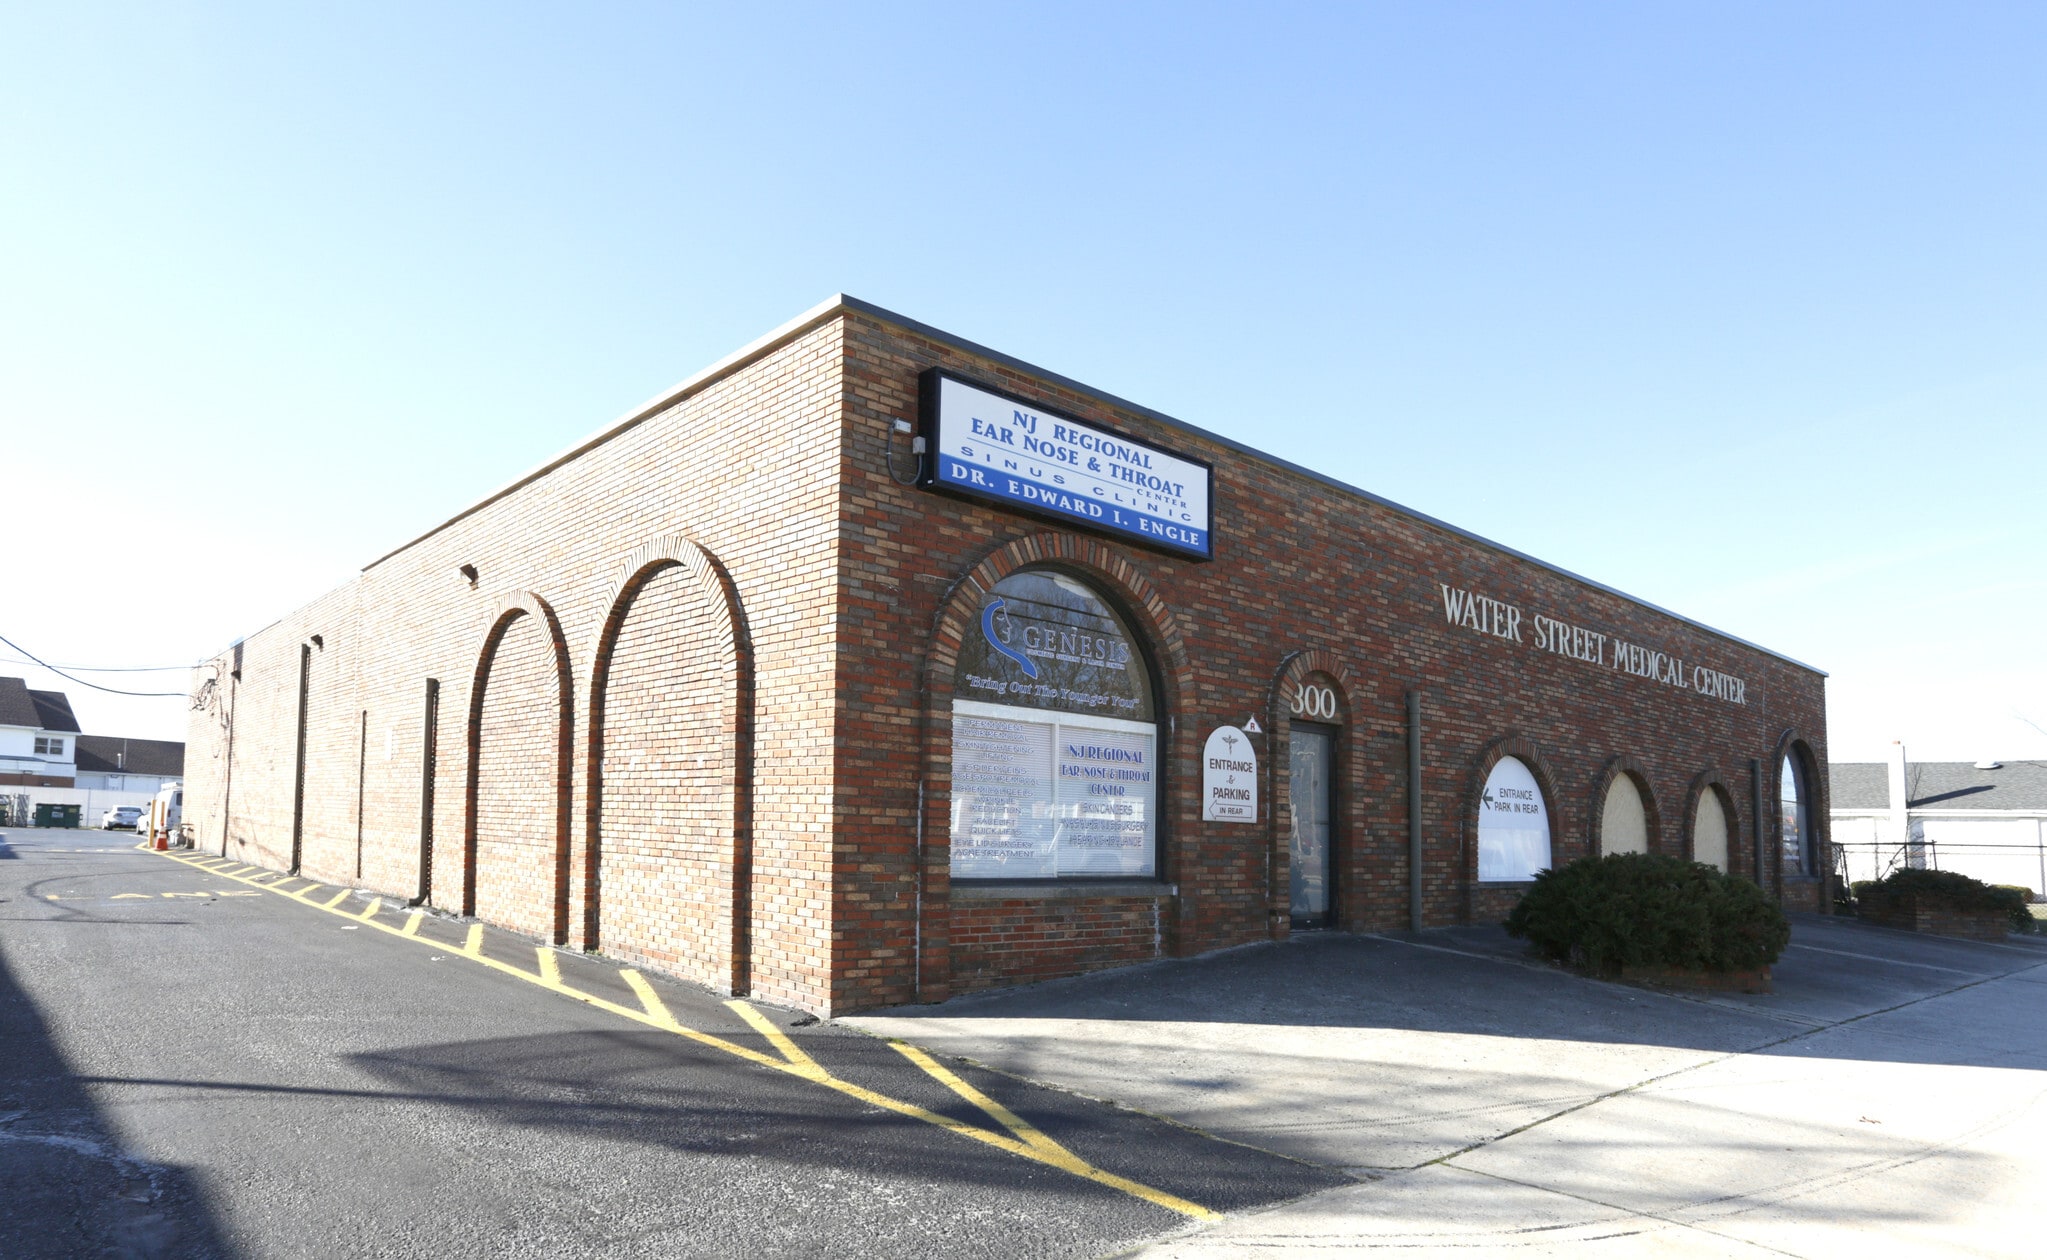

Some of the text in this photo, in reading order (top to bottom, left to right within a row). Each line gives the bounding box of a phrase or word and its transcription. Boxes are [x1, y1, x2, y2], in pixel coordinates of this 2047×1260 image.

[1013, 410, 1152, 469] NJ REGIONAL
[971, 417, 1184, 497] EAR NOSE & THROAT
[961, 446, 1192, 522] SINUS CLINIC
[951, 462, 1200, 546] DR. EDWARD I. ENGLE
[1136, 489, 1188, 509] CENTER
[1022, 626, 1129, 664] GENESIS
[1439, 582, 1746, 706] WATER STREET MEDICAL CENTER
[1010, 681, 1033, 695] Out
[1035, 684, 1058, 698] The
[1060, 688, 1109, 707] Younger
[1290, 683, 1336, 719] 300
[1250, 722, 1256, 731] R
[1069, 744, 1145, 764] NJ REGIONAL
[1084, 766, 1107, 779] NOSE
[1109, 768, 1115, 779] &
[1118, 769, 1151, 782] THROAT
[1209, 758, 1253, 773] ENTRANCE
[1091, 783, 1125, 796] CENTER
[1226, 775, 1236, 784] &
[1213, 787, 1250, 801] PARKING
[1499, 788, 1533, 801] ENTRANCE
[1220, 806, 1243, 815] IN REAR
[1494, 801, 1539, 814] PARK IN REAR
